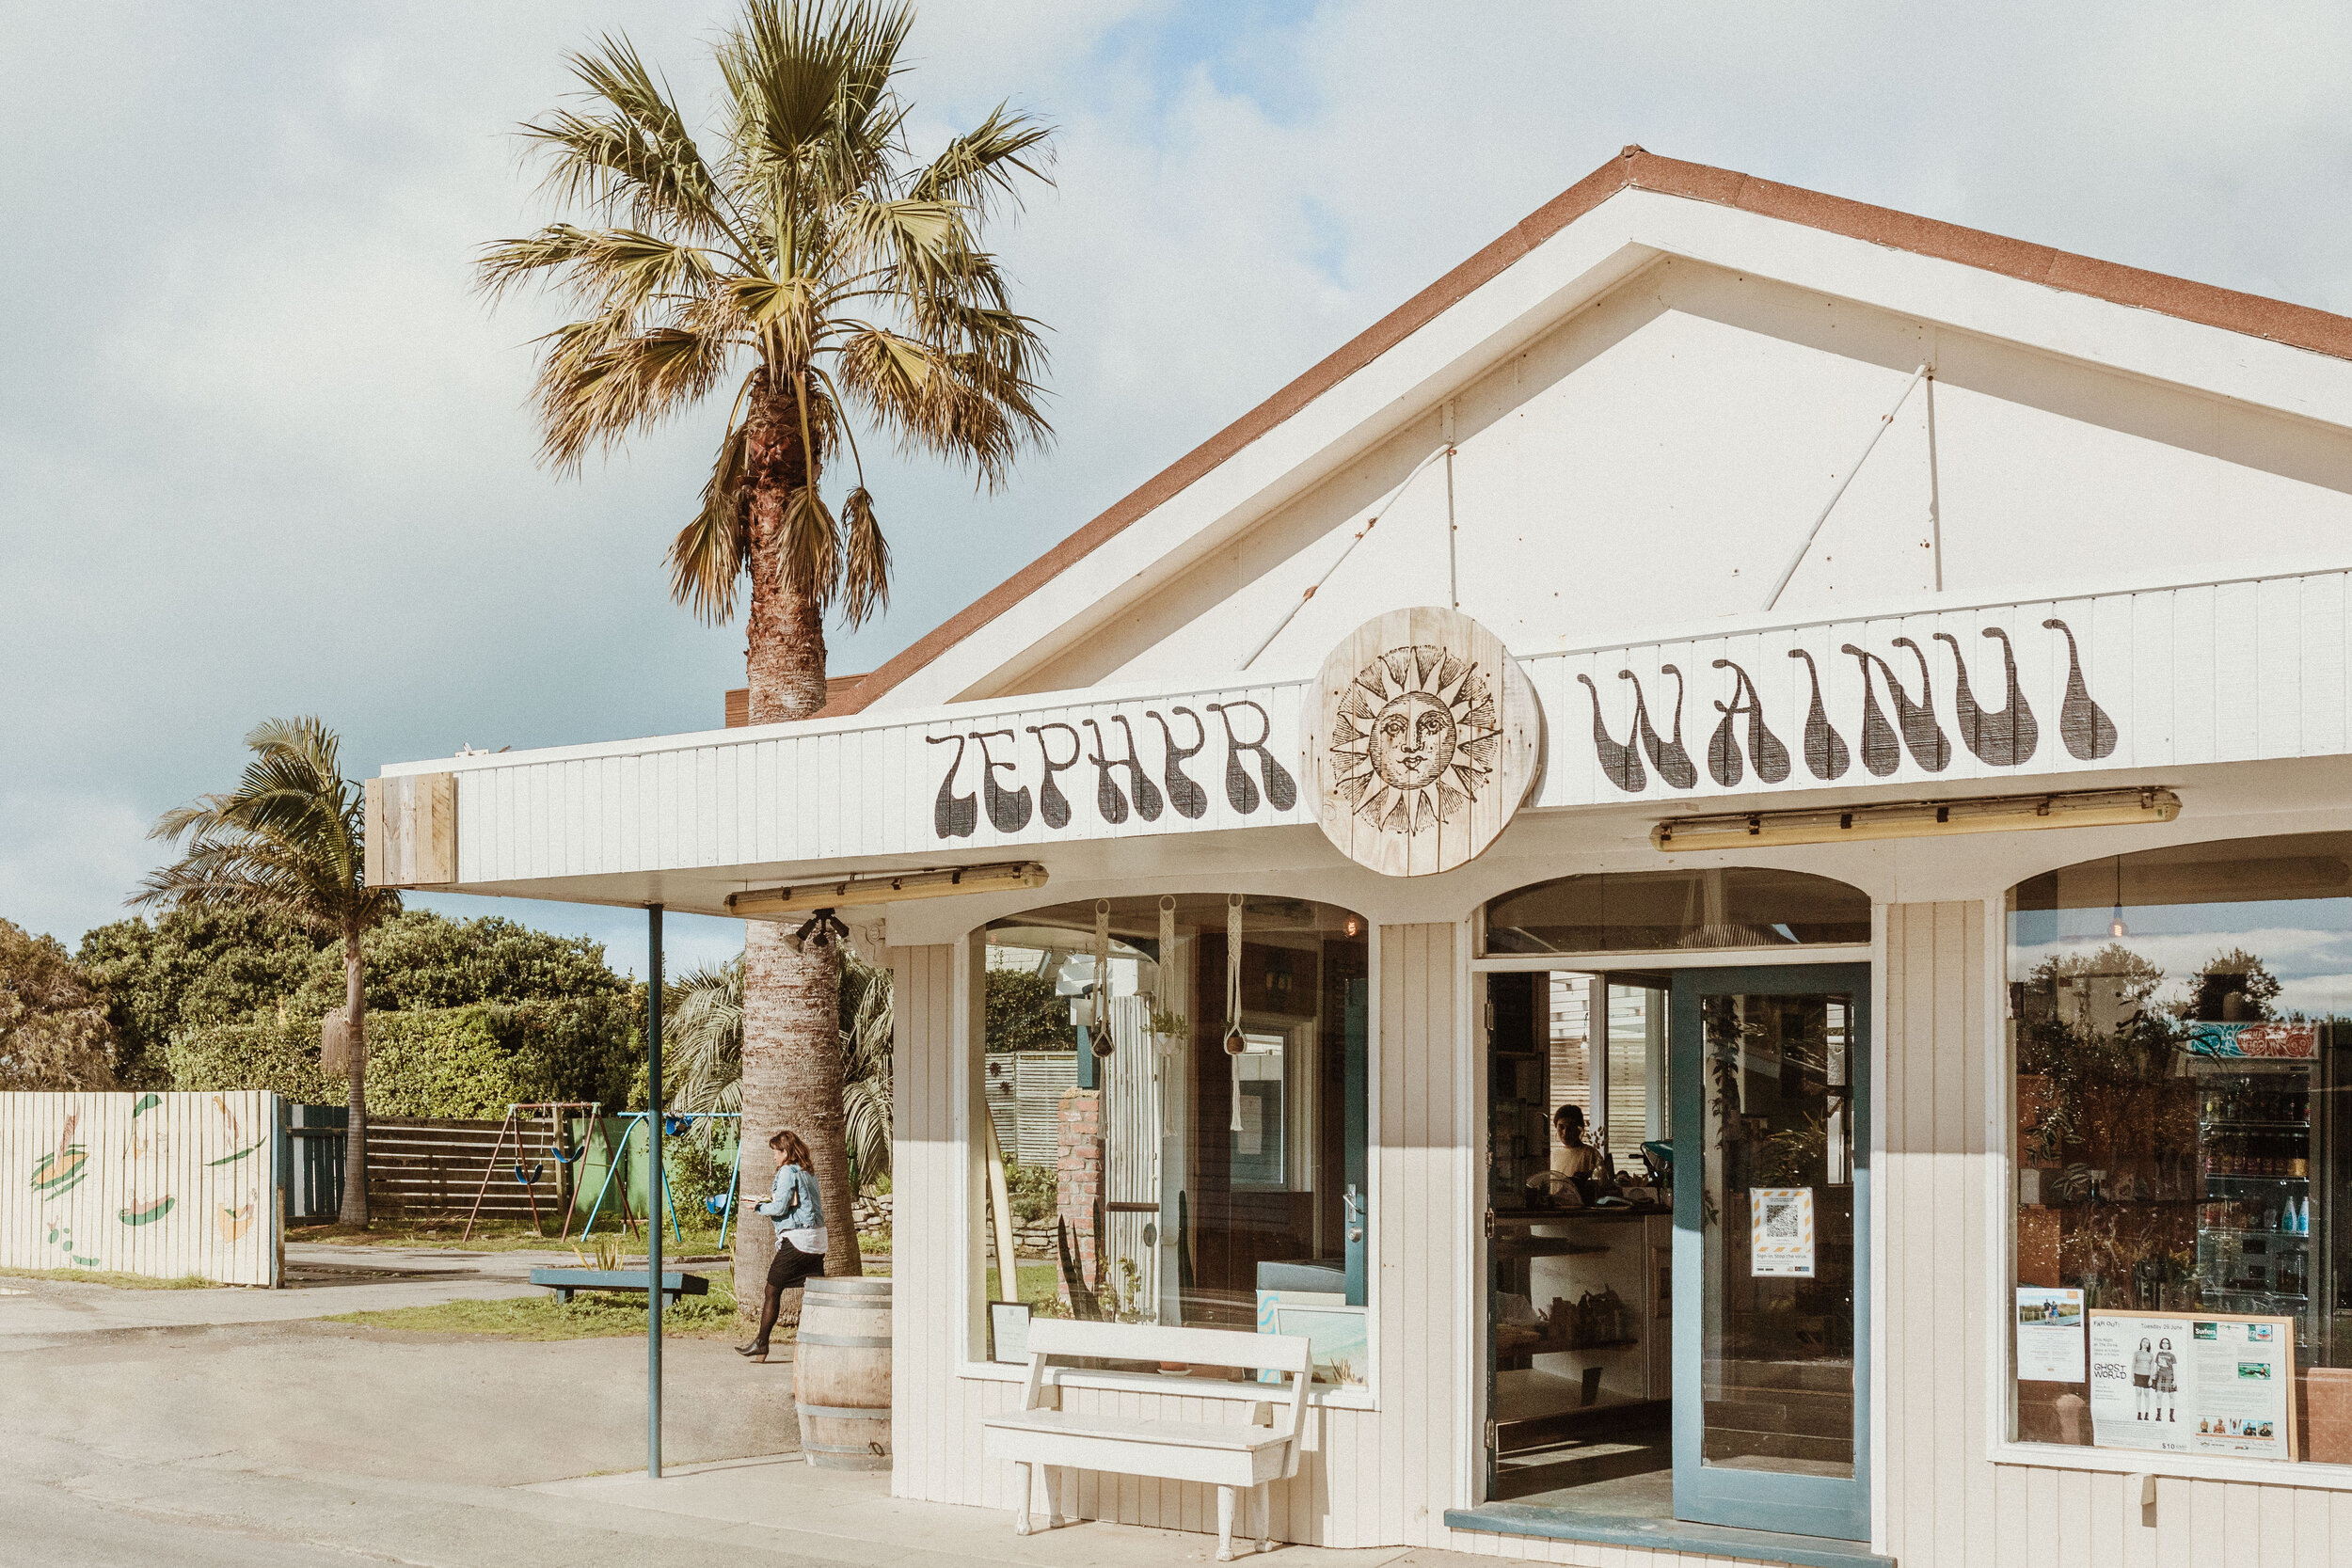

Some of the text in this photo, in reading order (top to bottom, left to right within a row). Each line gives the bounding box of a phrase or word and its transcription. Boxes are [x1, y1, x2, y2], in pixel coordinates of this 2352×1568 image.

[925, 619, 2118, 839] ZEPHYR WAINUI
[2093, 1363, 2127, 1372] GHOST
[2093, 1371, 2127, 1380] WORLD
